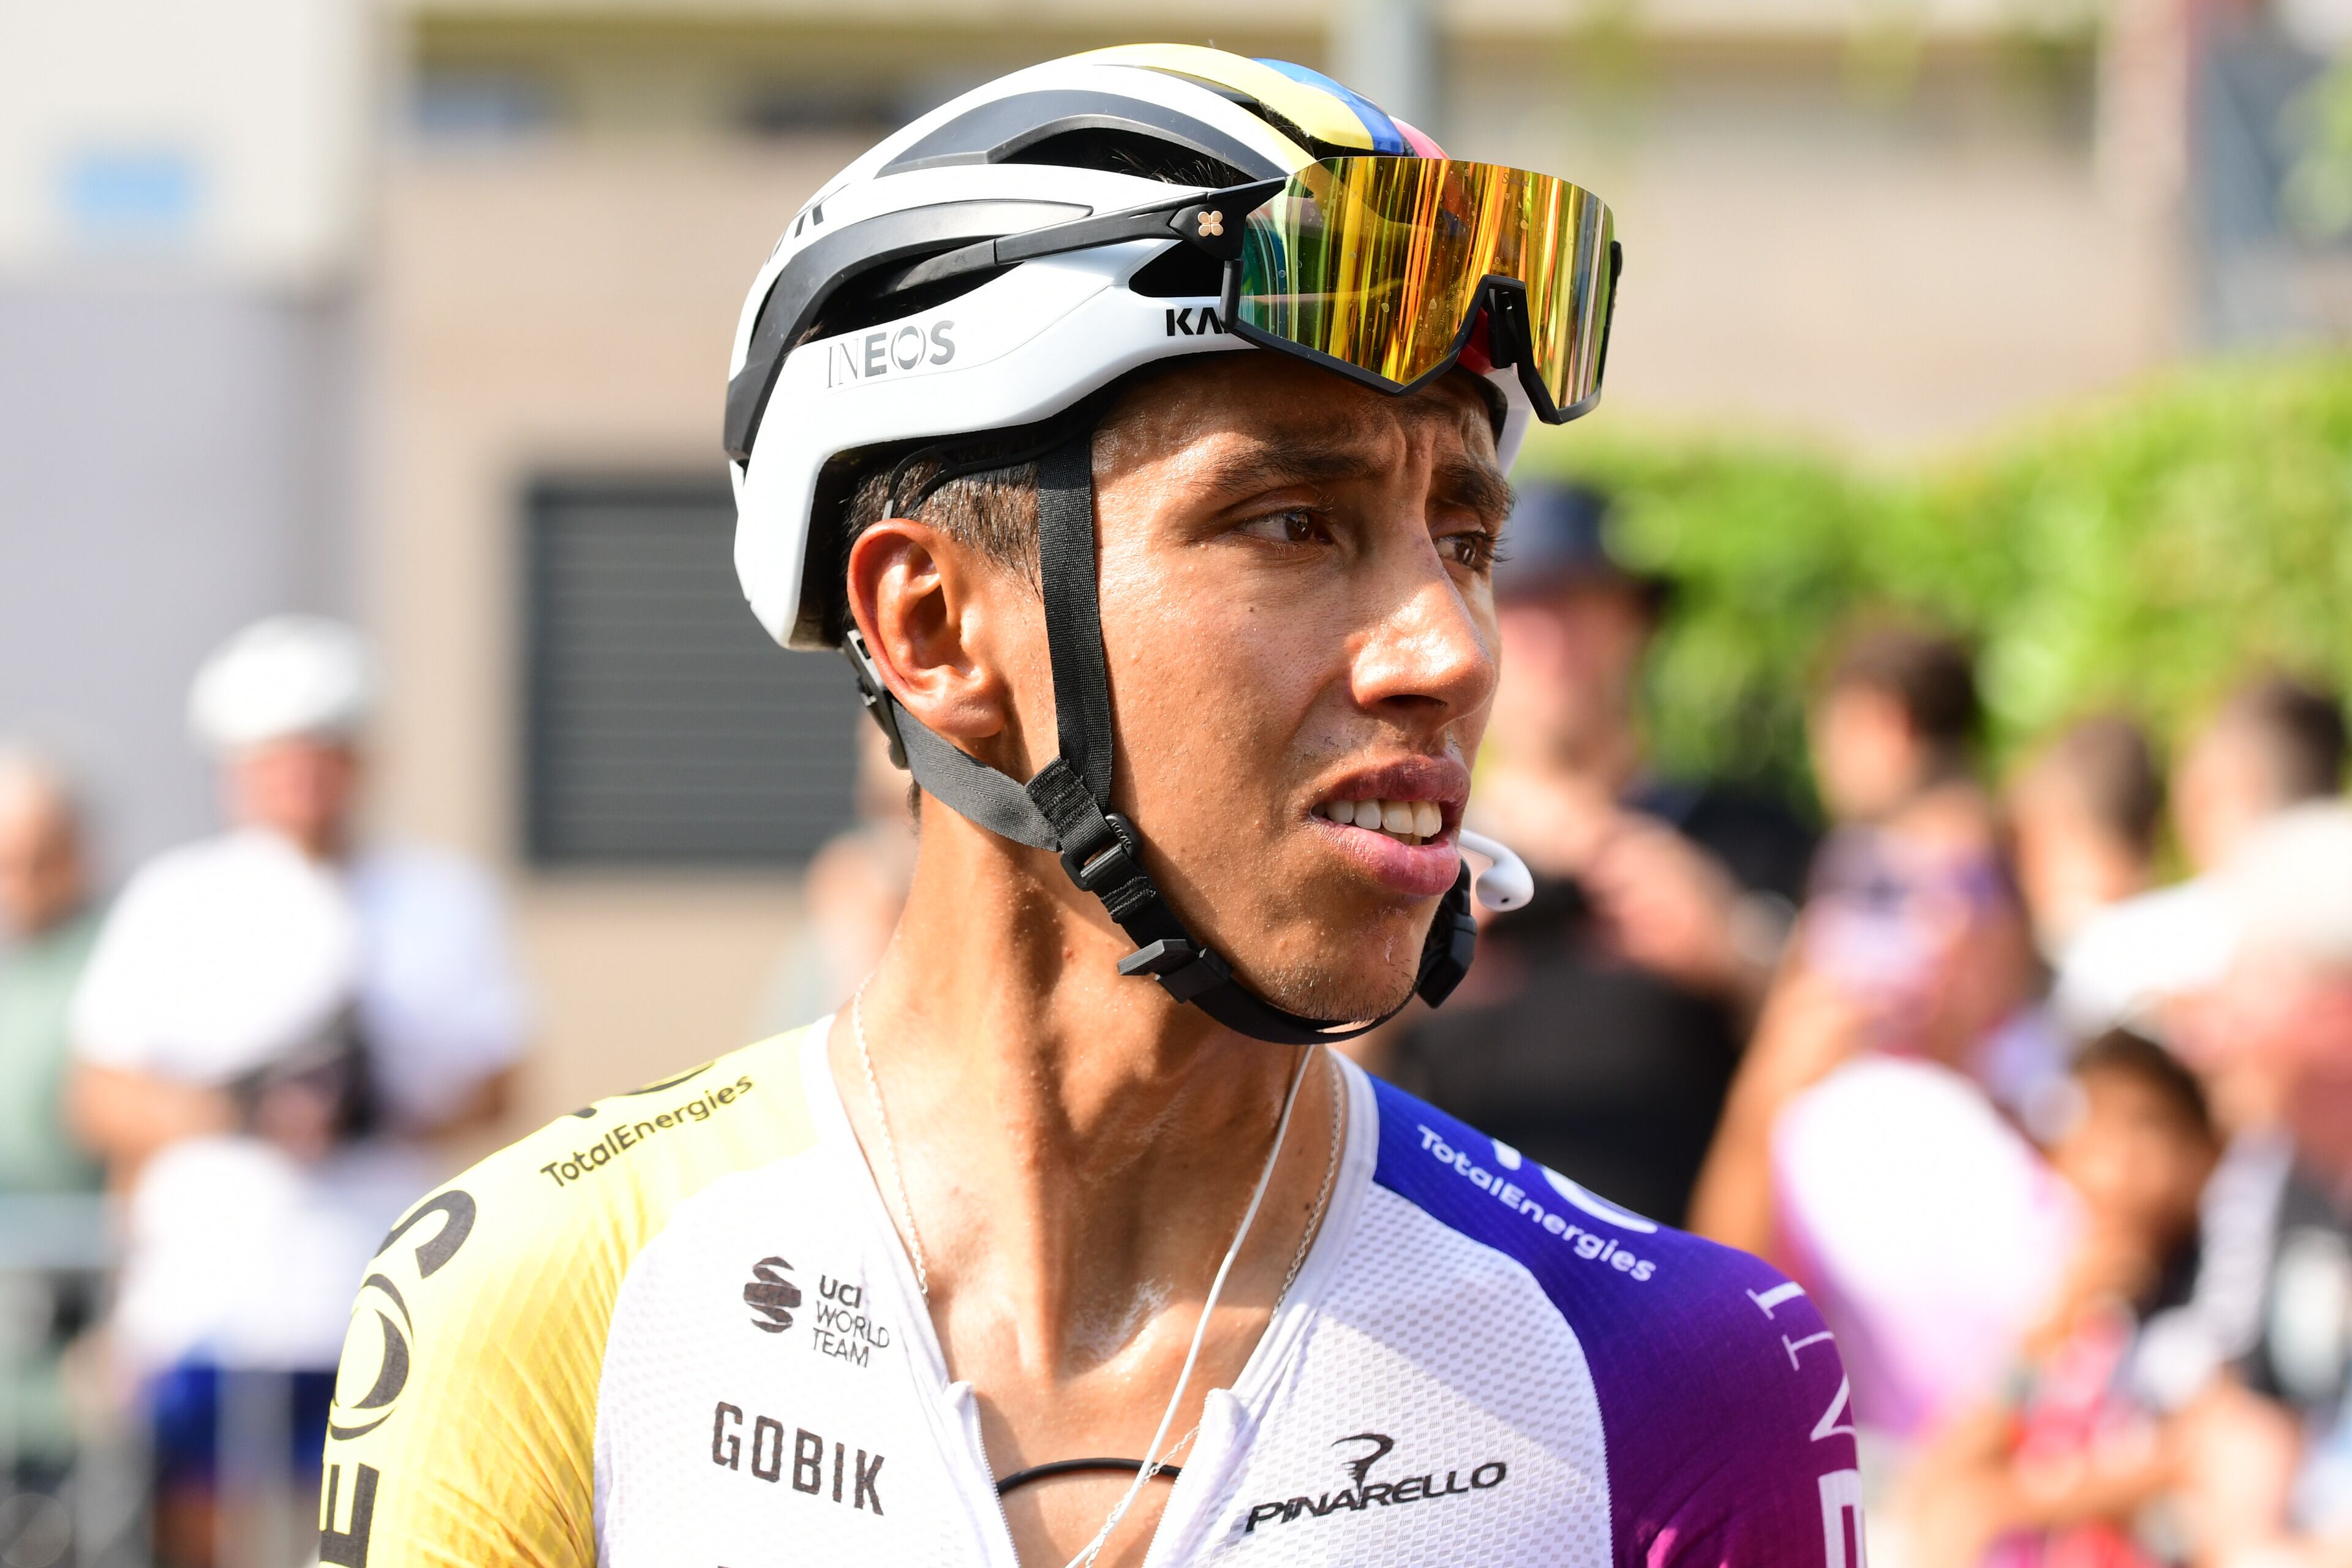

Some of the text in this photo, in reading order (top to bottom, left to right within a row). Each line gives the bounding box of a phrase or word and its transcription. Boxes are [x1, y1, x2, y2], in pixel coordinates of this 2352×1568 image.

[827, 320, 956, 388] INEOS
[1166, 307, 1230, 336] KA
[540, 1076, 753, 1187] TotalEnergies
[1417, 1123, 1657, 1281] TotalEnergies
[816, 1301, 890, 1348] WORLD
[819, 1275, 863, 1309] UCI
[813, 1327, 870, 1368] TEAM
[712, 1401, 885, 1517] GOBIK
[1243, 1461, 1508, 1534] PINARELLO
